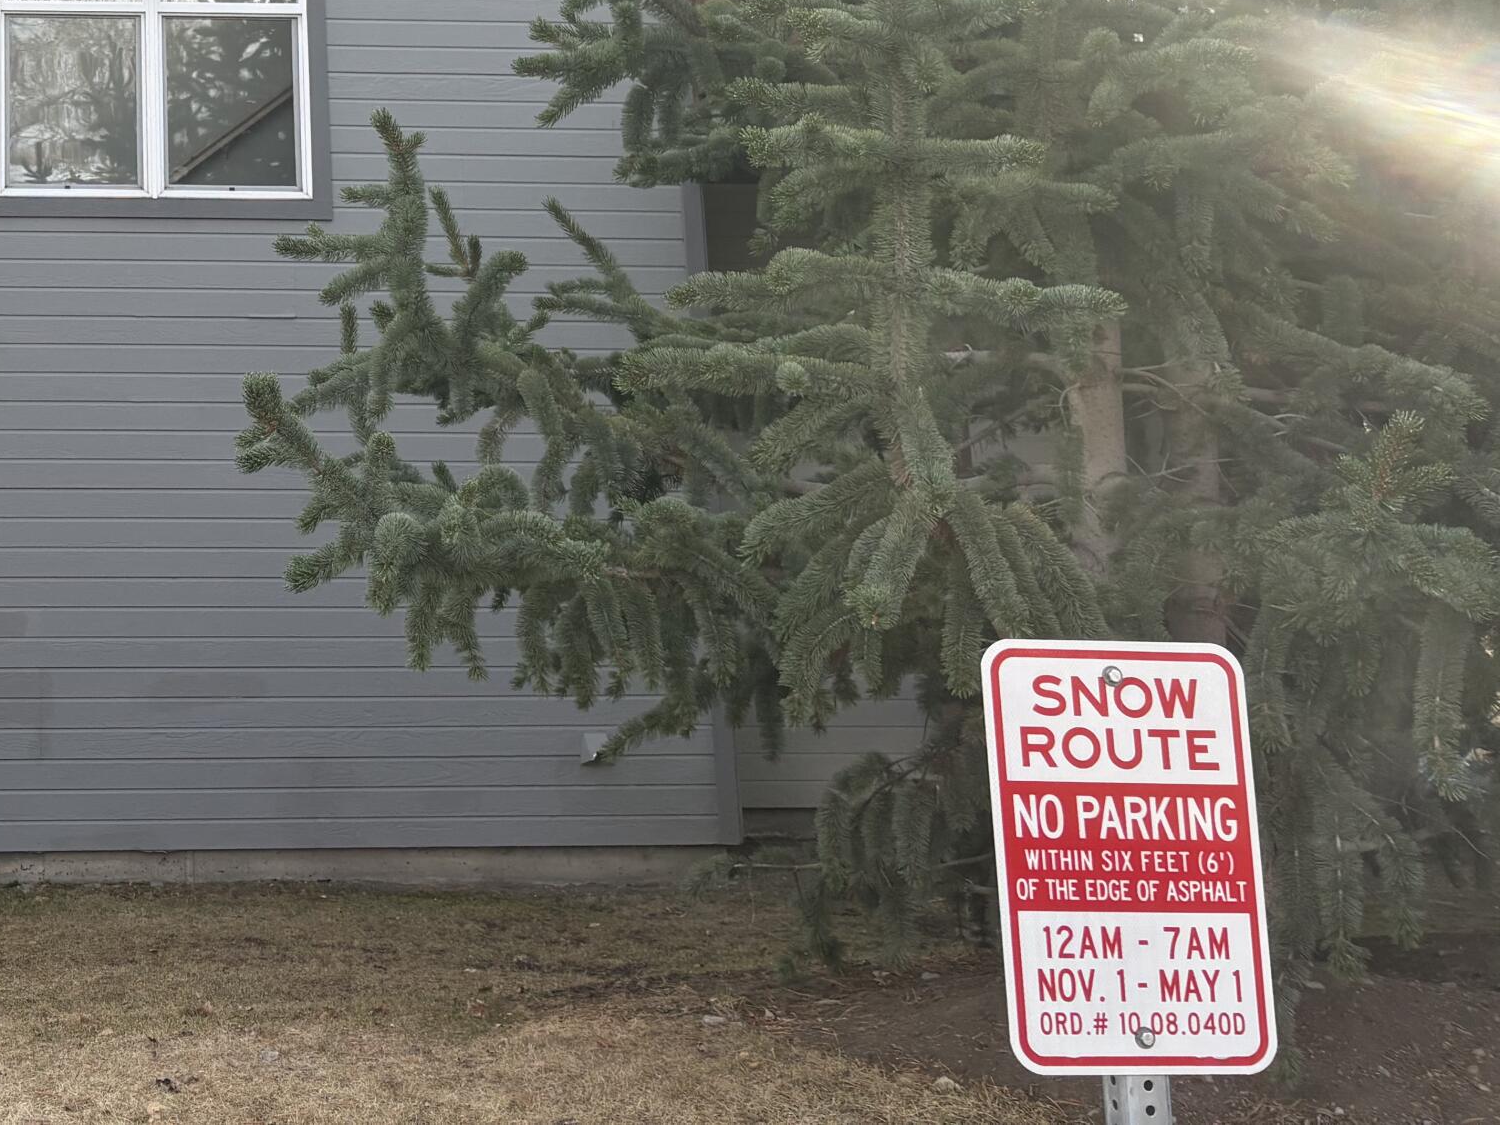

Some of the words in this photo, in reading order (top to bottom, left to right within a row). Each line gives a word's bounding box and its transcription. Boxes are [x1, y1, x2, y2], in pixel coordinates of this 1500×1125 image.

[1032, 675, 1197, 719] SNOW
[1019, 726, 1220, 771] ROUTE
[1013, 794, 1064, 839] NO
[1076, 795, 1238, 842] PARKING
[1025, 849, 1092, 871] WITHIN
[1101, 850, 1133, 872] SIX
[1141, 851, 1190, 873] FEET
[1198, 851, 1234, 874] (6')
[1016, 879, 1037, 900] OF
[1045, 879, 1079, 900] THE
[1086, 880, 1131, 901] EDGE
[1137, 880, 1159, 901] OF
[1167, 881, 1247, 902] ASPHALT
[1043, 925, 1123, 960] 12AM
[1138, 938, 1148, 946] -
[1163, 926, 1230, 960] 7AM
[1038, 969, 1105, 1002] NOV.
[1117, 969, 1127, 1002] 1
[1159, 969, 1220, 1002] MAY
[1233, 970, 1242, 1002] 1
[1040, 1012, 1108, 1035] ORD.#
[1119, 1013, 1246, 1035] 1008.040D
